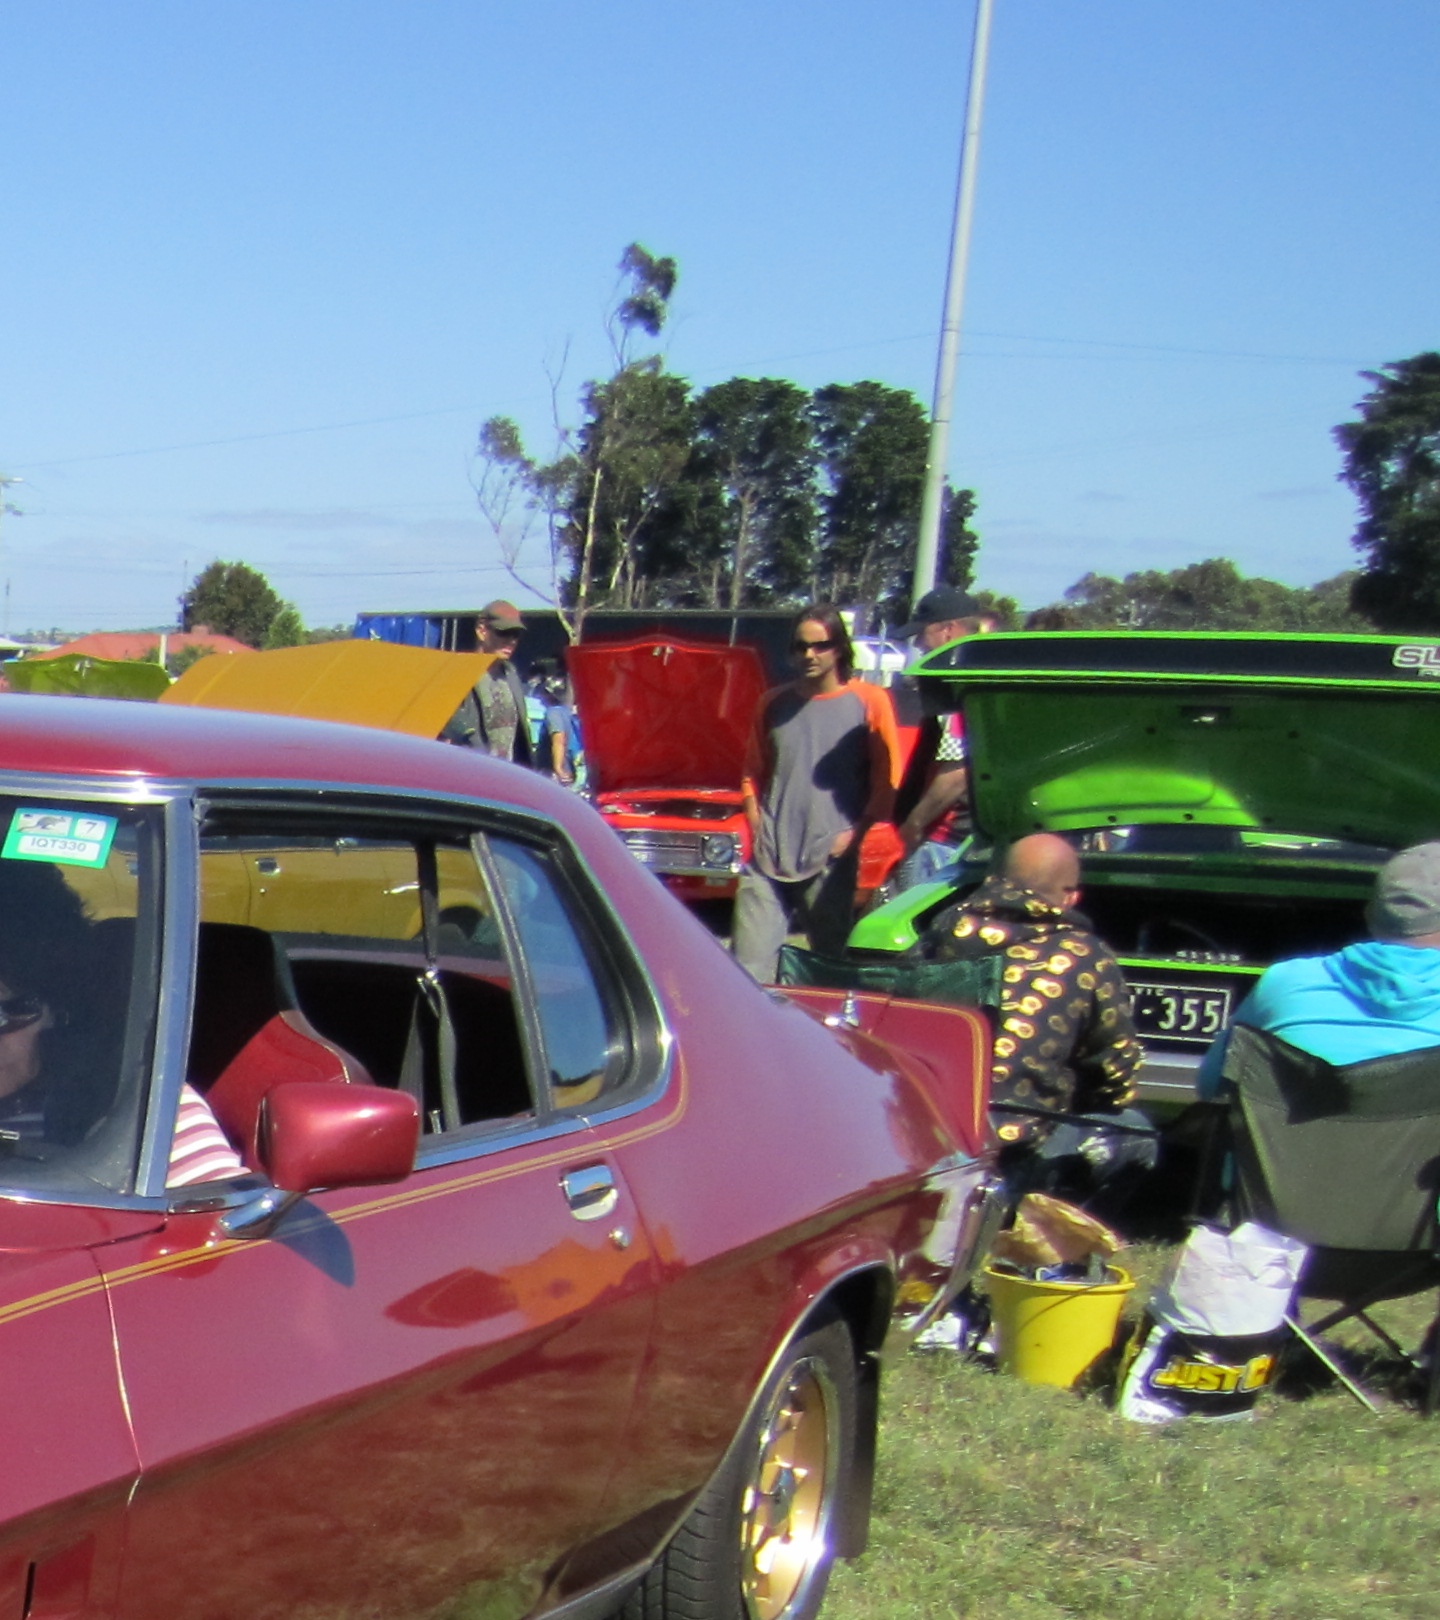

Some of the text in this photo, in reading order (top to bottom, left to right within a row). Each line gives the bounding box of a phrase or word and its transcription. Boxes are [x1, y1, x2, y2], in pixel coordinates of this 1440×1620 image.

[85, 821, 97, 835] 7
[31, 837, 87, 852] IQT330
[1134, 987, 1165, 996] VIC
[1150, 1359, 1244, 1394] JUST
